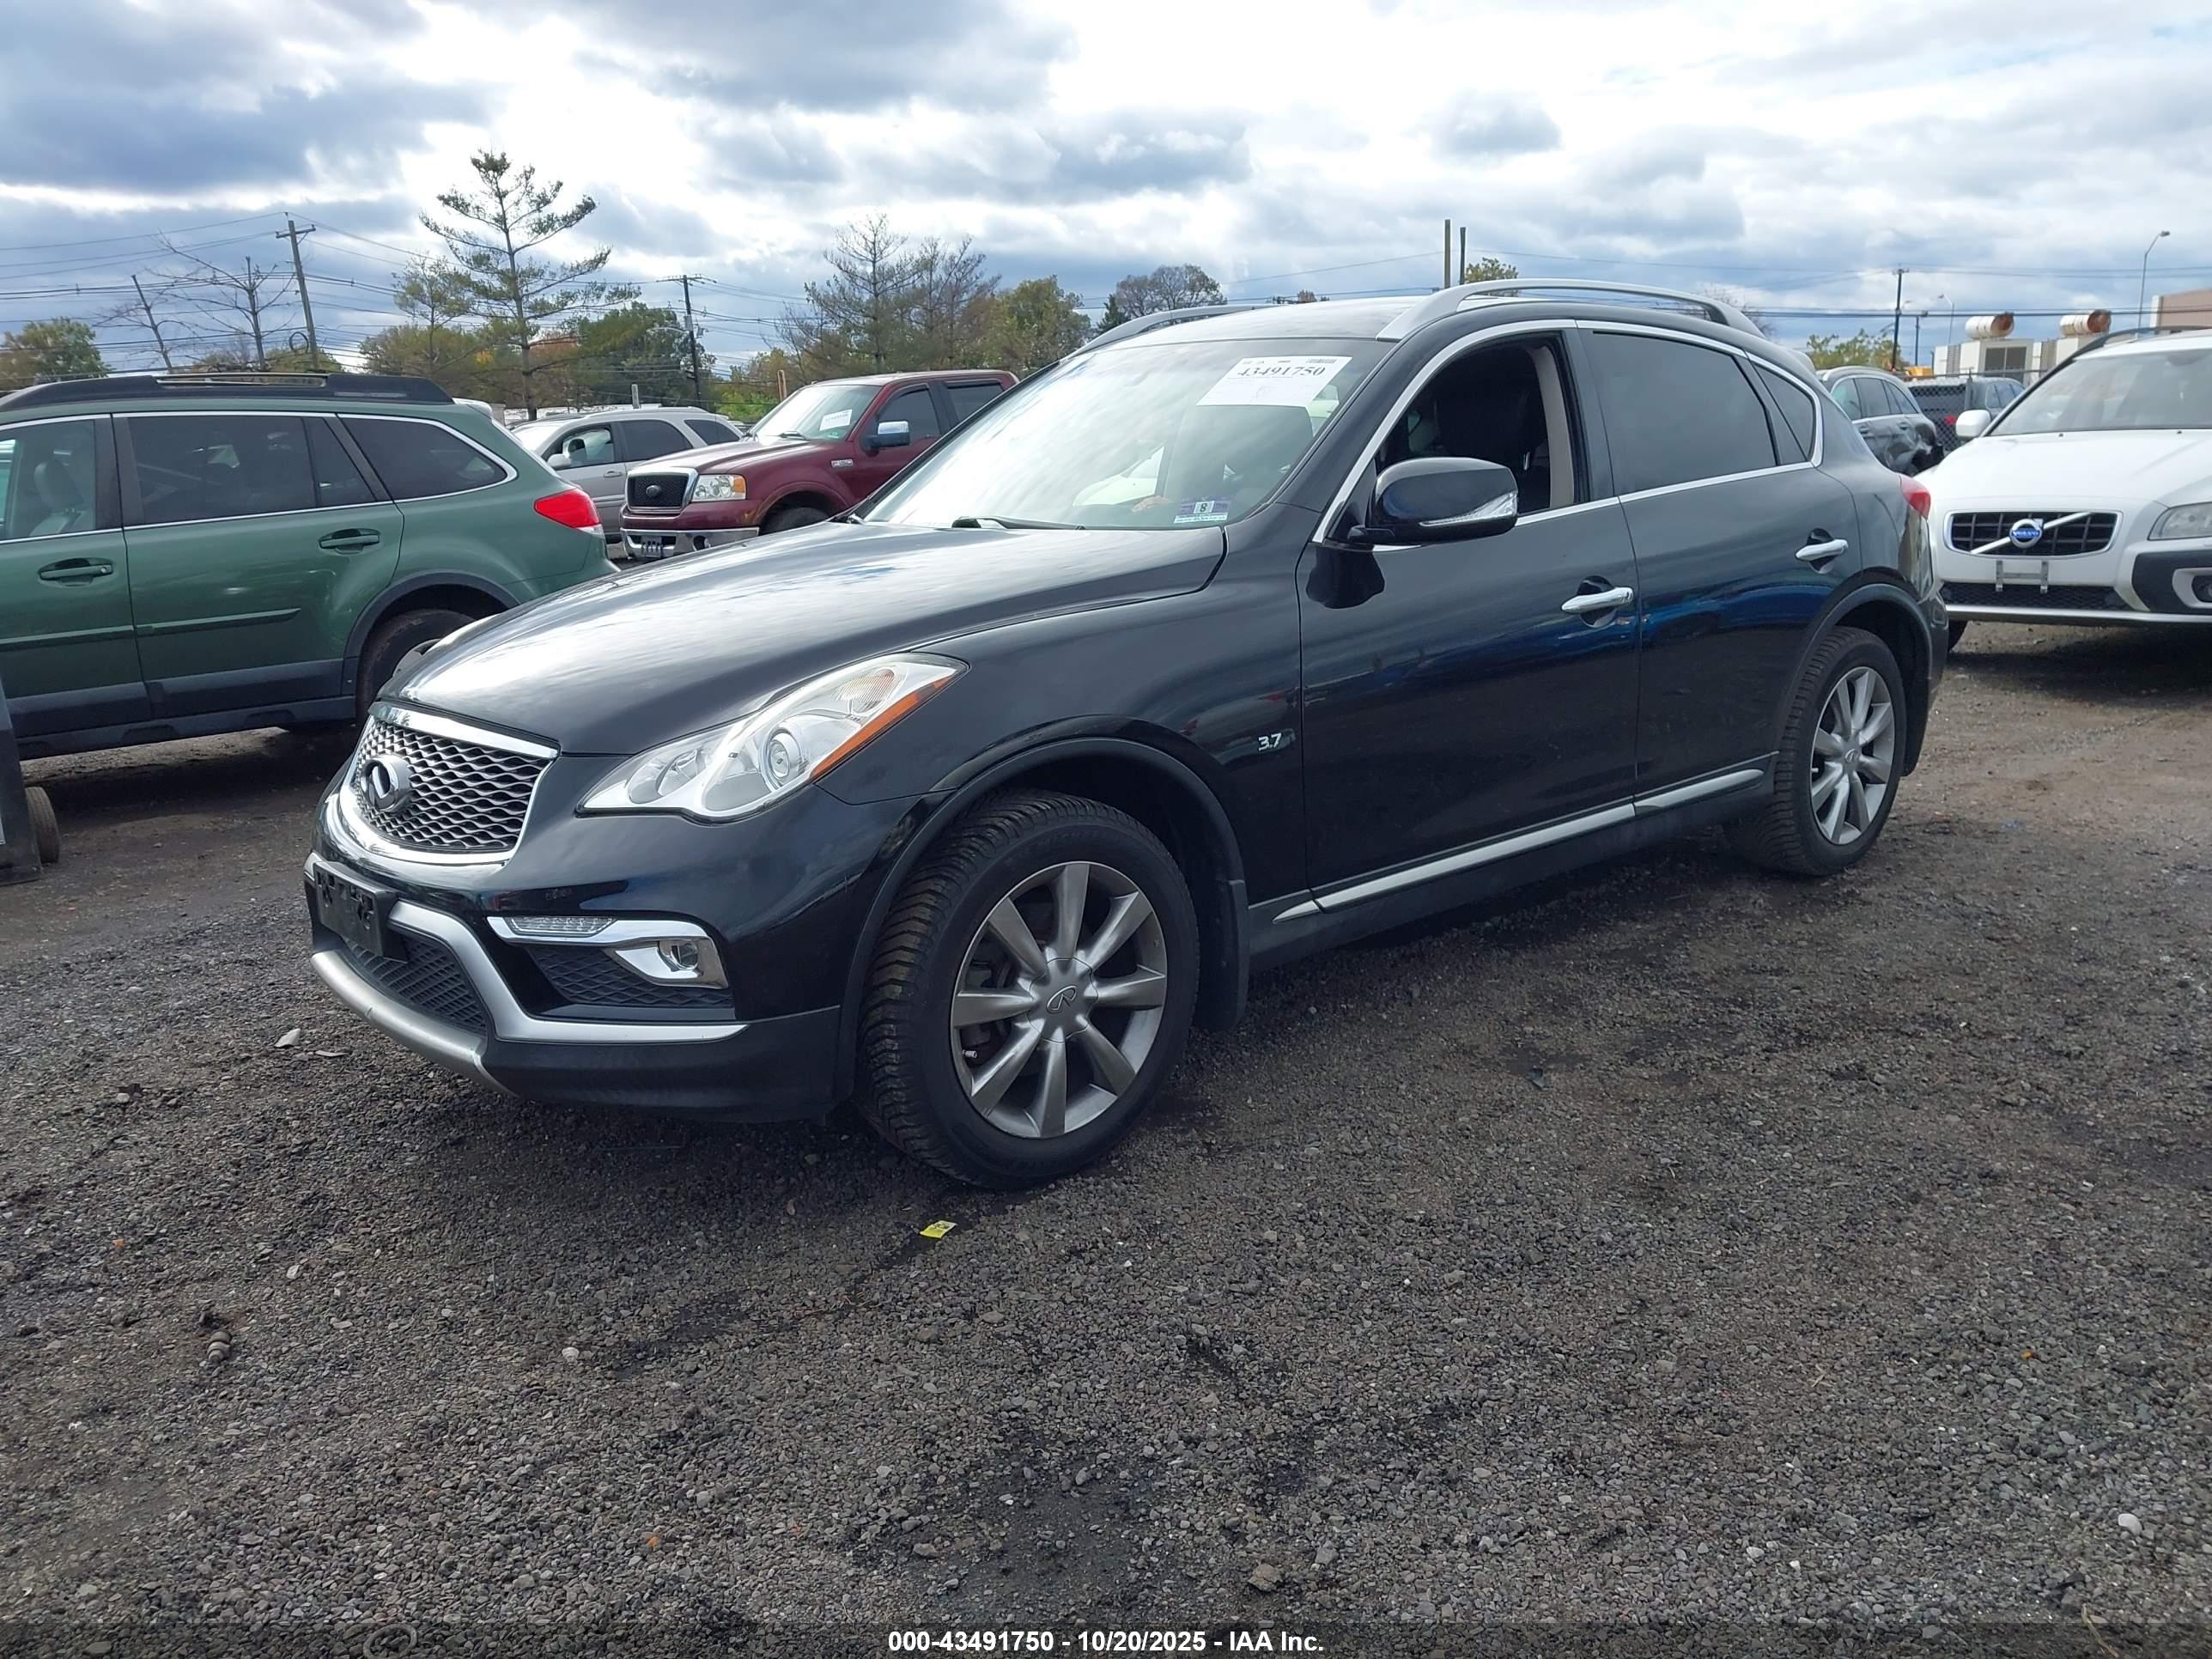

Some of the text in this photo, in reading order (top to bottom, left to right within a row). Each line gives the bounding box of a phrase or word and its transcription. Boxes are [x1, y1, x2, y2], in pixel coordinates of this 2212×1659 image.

[1237, 365, 1327, 377] 43491750
[1199, 502, 1208, 513] 8
[1258, 732, 1282, 751] 3.7
